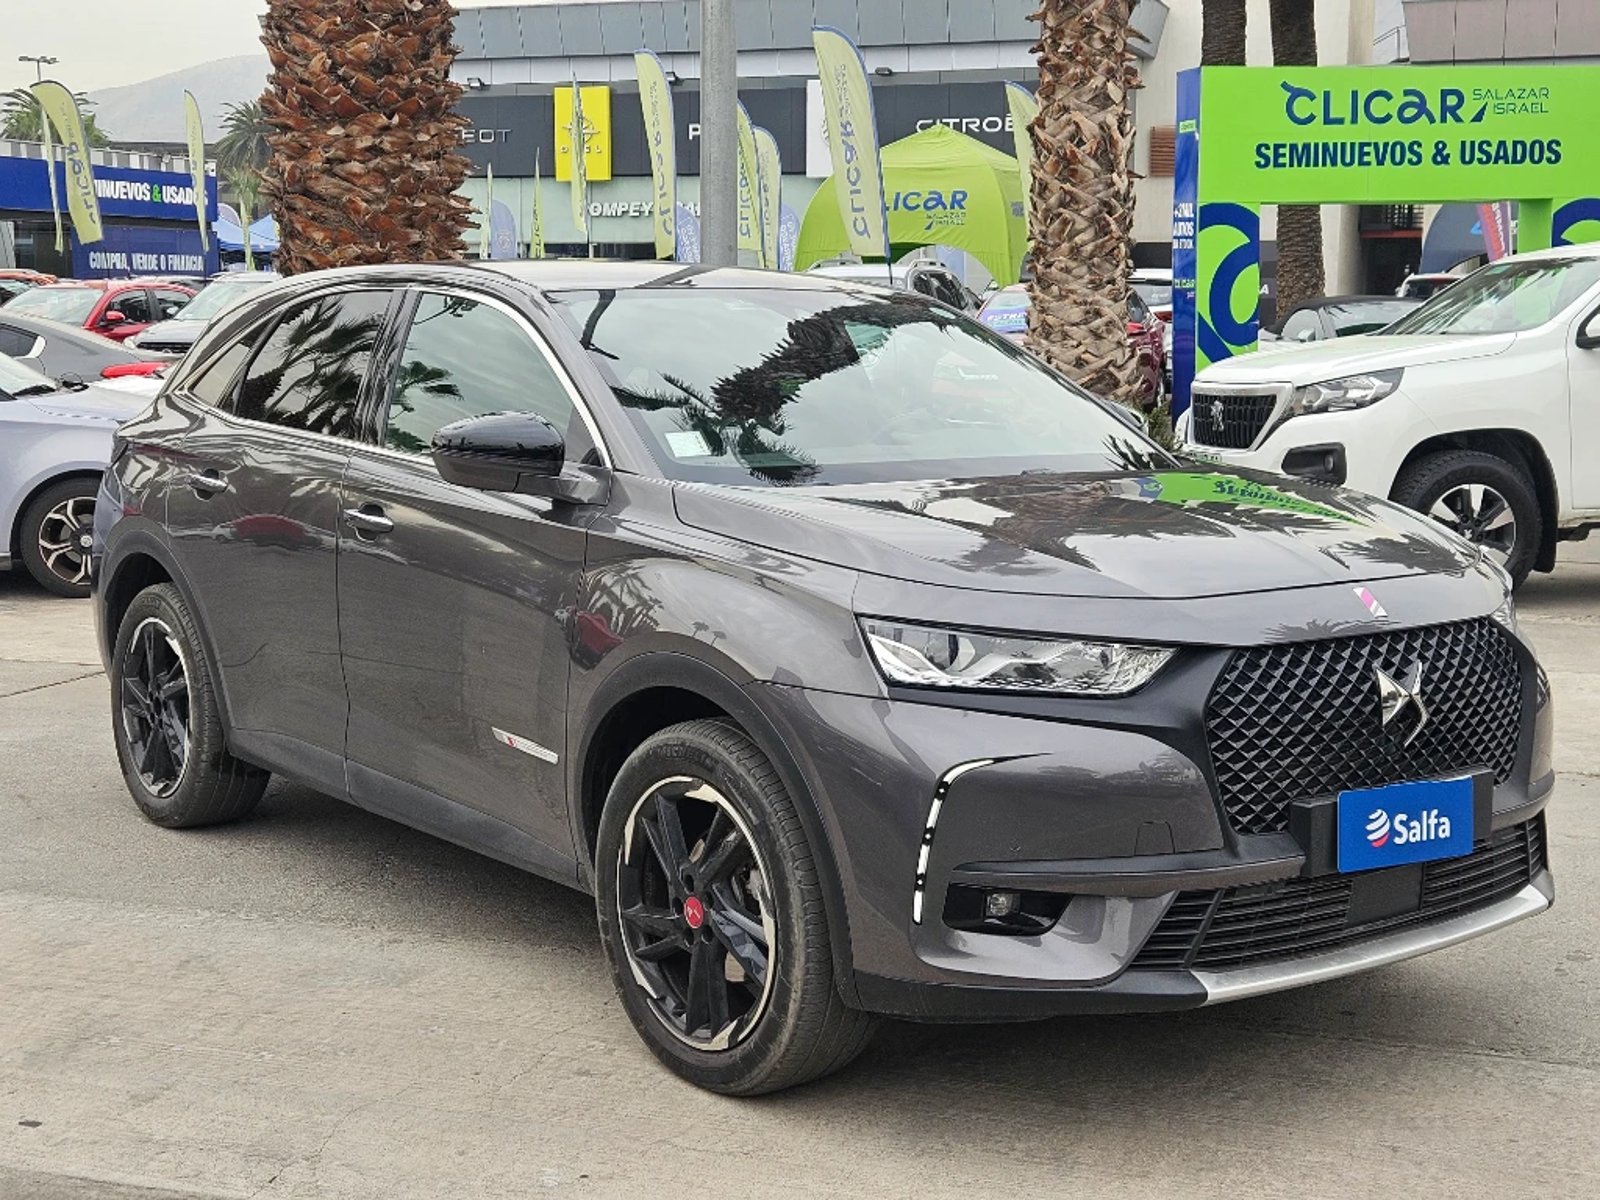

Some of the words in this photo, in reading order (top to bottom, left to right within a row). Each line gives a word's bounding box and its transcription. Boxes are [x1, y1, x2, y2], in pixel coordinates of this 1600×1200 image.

[1472, 87, 1550, 101] SALAZAR
[1493, 102, 1549, 115] ISRAEL
[462, 128, 512, 143] EOT
[1254, 140, 1423, 169] SEMINUEVOS
[1431, 139, 1451, 166] &
[1460, 139, 1562, 166] USADOS
[94, 179, 150, 201] INUEVOS
[152, 184, 161, 202] &
[162, 186, 208, 205] USADS
[588, 202, 654, 217] OMPEY
[131, 252, 158, 270] VENDE
[160, 254, 166, 270] O
[167, 254, 203, 271] FINANCIA
[1393, 808, 1451, 845] Salfa
